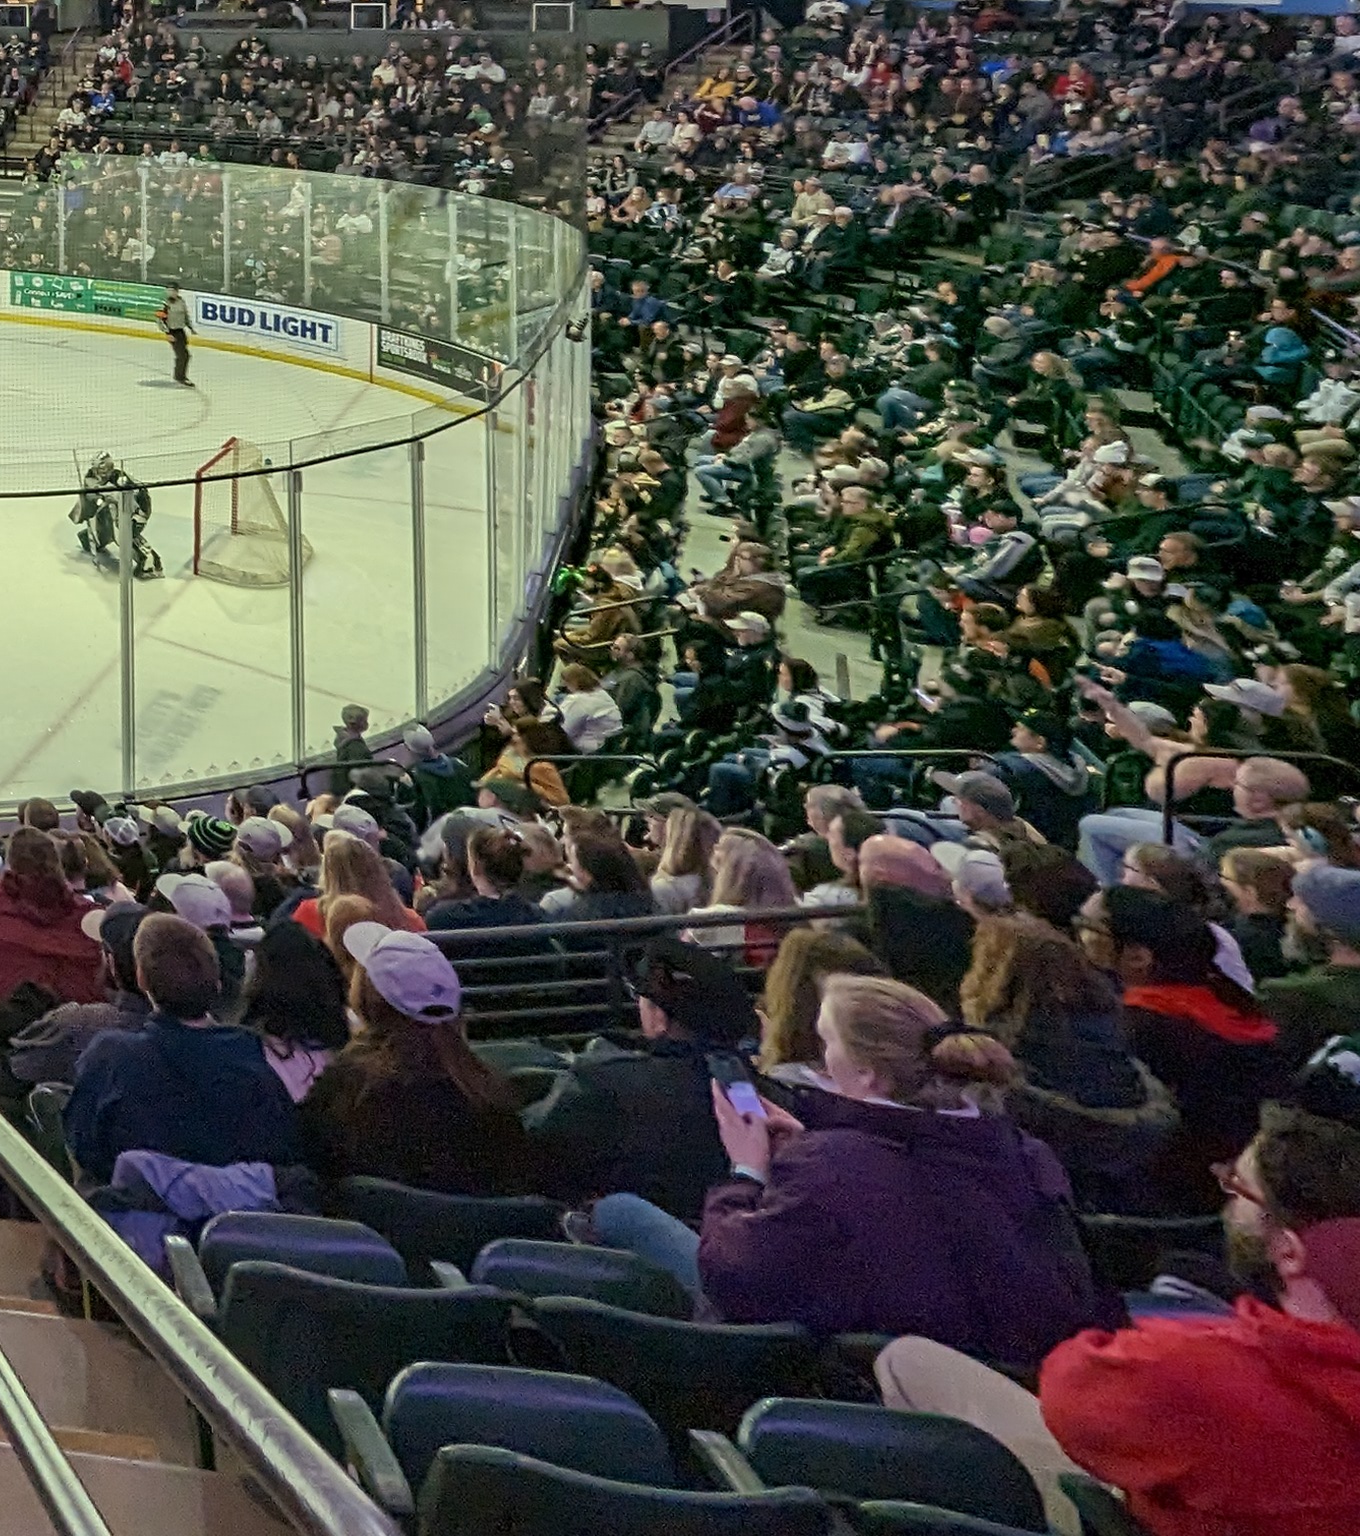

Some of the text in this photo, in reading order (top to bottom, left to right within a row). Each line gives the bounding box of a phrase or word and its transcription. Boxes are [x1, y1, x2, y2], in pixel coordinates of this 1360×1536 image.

[202, 301, 333, 344] BUD LIGHT
[380, 326, 426, 352] DRAFTKINGS
[380, 340, 428, 363] SPORTSBOOK
